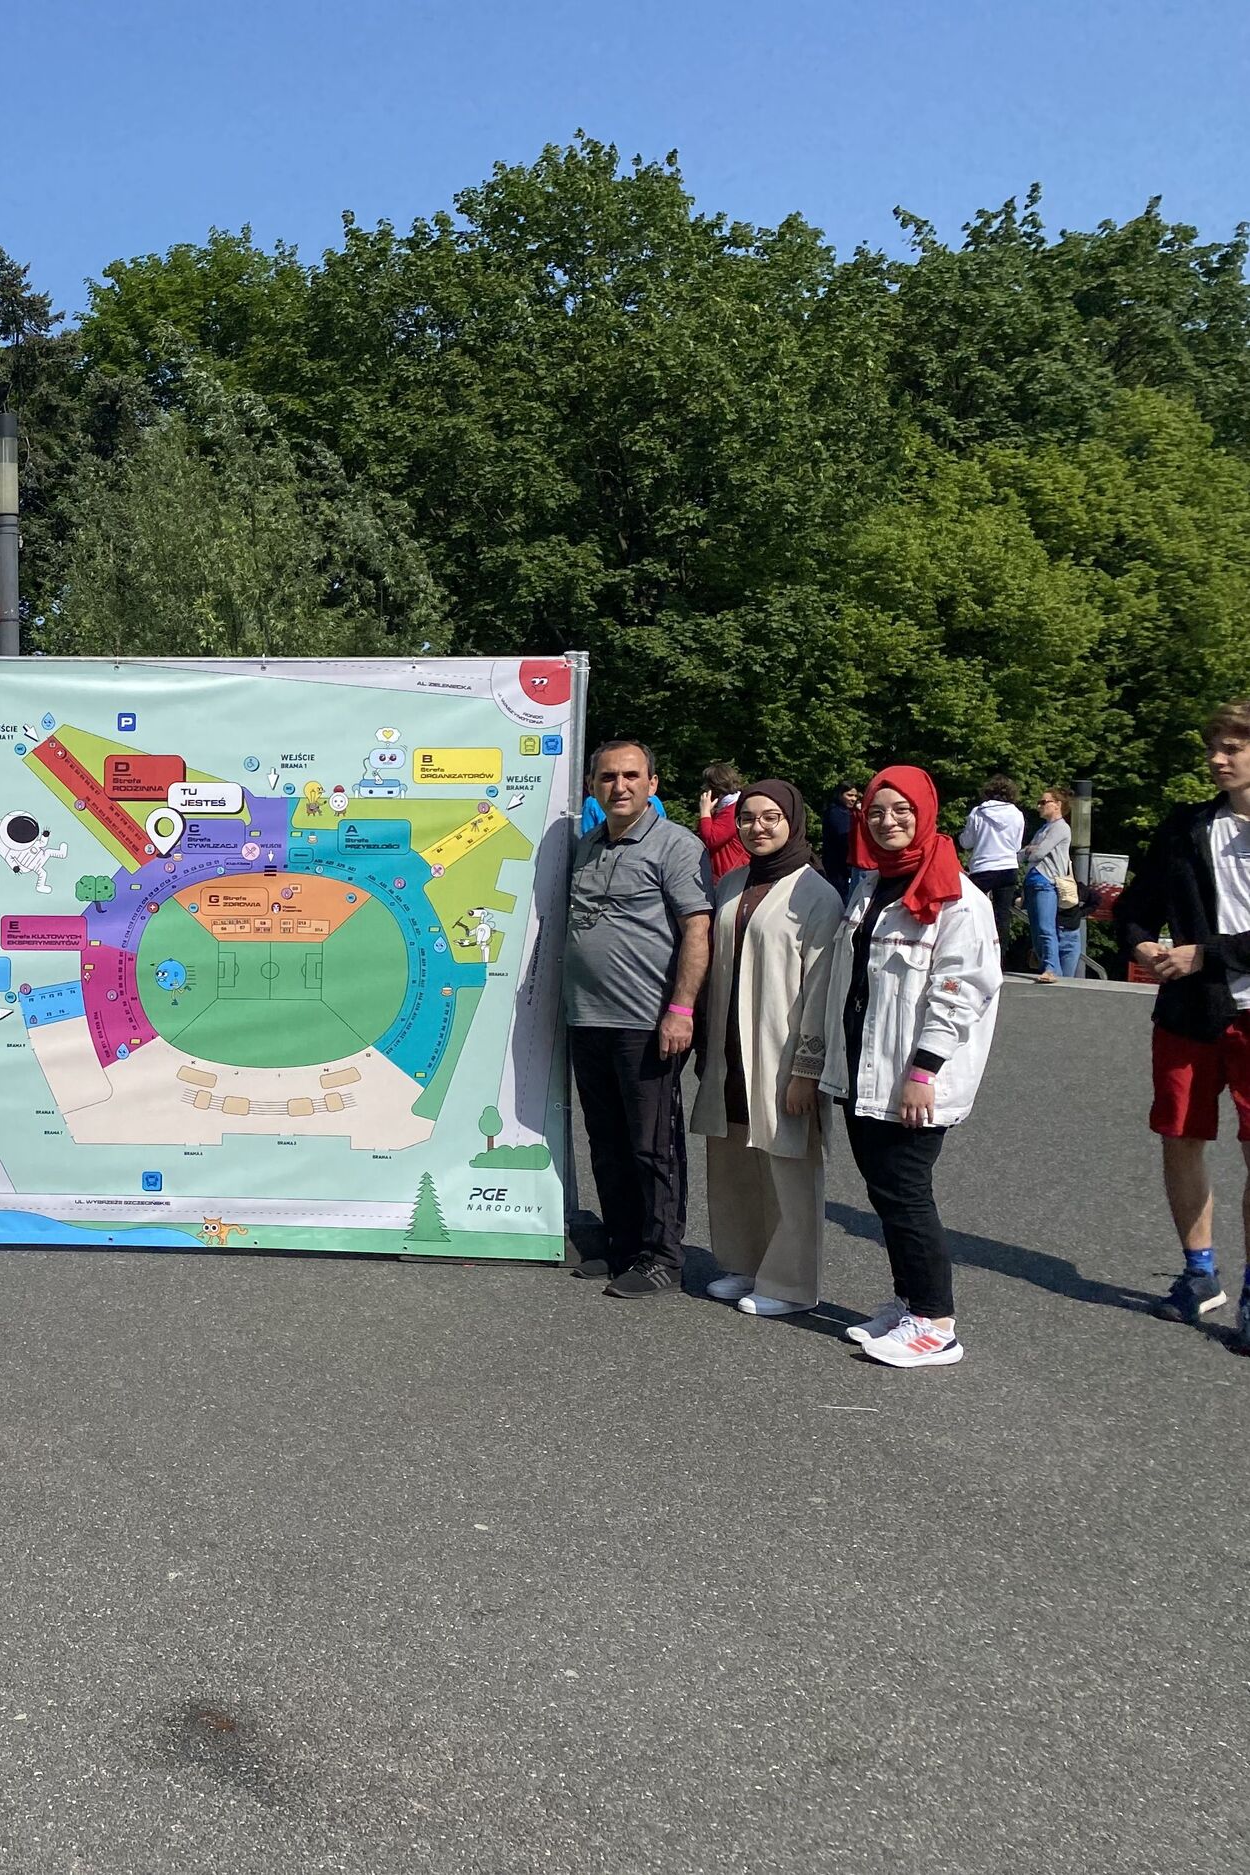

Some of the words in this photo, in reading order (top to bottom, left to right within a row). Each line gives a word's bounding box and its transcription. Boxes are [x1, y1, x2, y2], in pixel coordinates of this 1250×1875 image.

[121, 717, 132, 727] P
[281, 752, 315, 761] WEJŚCIE
[422, 755, 433, 763] B
[114, 762, 129, 772] D
[506, 774, 542, 783] WEJŚCIE
[181, 788, 198, 796] TU
[180, 797, 227, 807] JESTEŚ
[188, 824, 200, 833] C
[345, 825, 358, 833] A
[209, 895, 220, 903] G
[9, 921, 19, 929] E
[469, 1188, 508, 1201] PGE
[466, 1203, 543, 1213] NARODOWY
